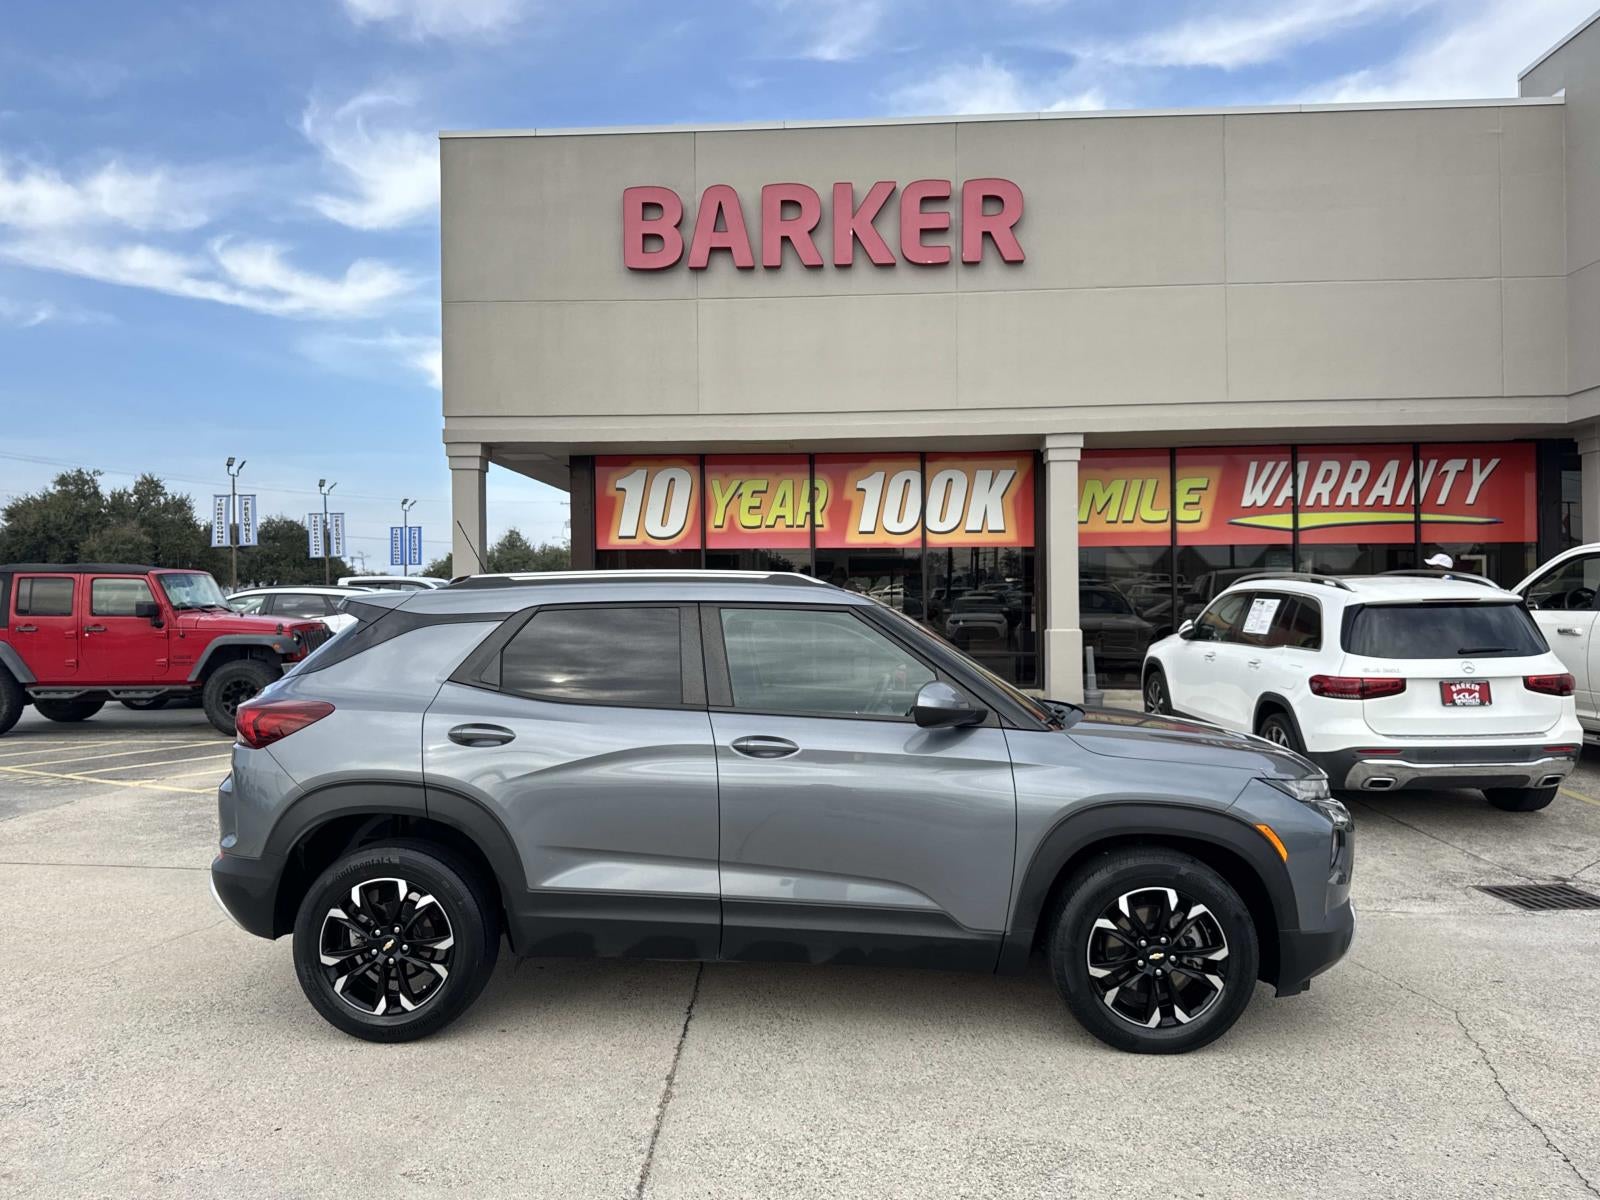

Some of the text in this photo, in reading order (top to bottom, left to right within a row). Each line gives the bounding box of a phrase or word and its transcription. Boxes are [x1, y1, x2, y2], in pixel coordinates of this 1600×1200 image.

[623, 178, 1026, 271] BARKER
[615, 458, 1501, 540] 10 YEAR 100K MILE WARRANTY
[1450, 683, 1480, 692] BARKER
